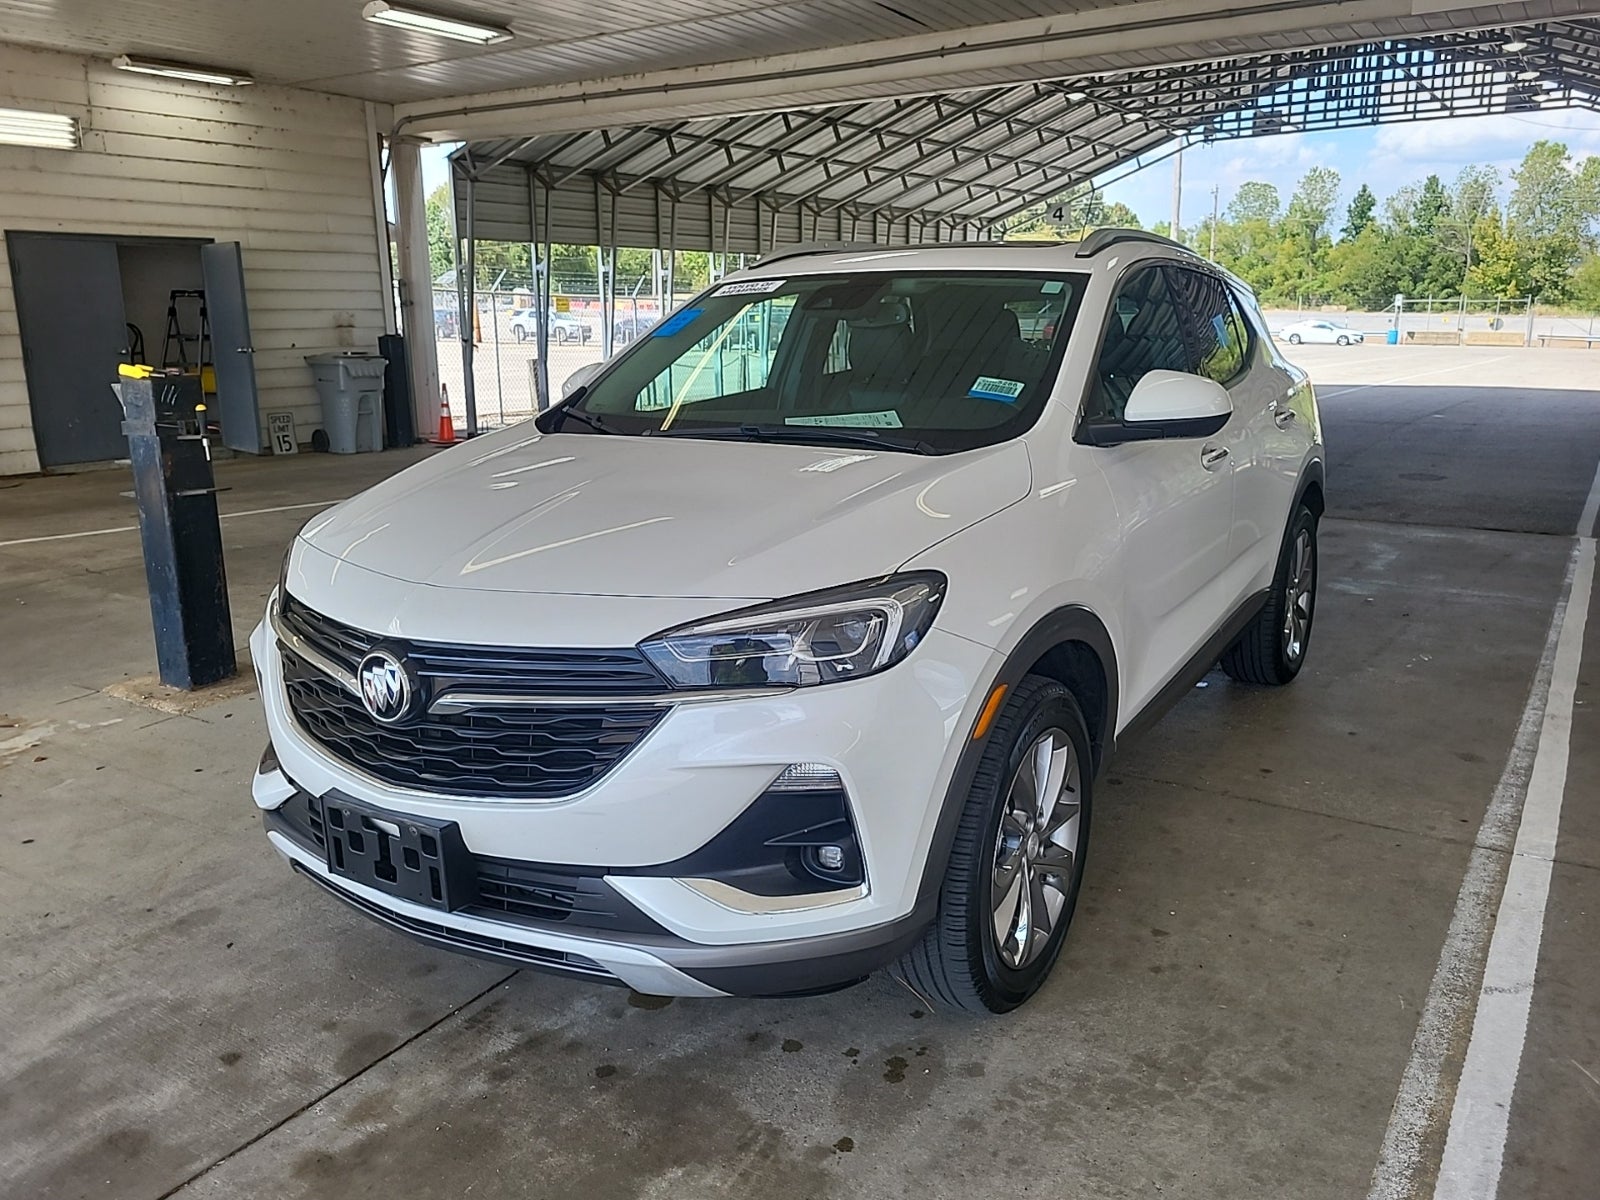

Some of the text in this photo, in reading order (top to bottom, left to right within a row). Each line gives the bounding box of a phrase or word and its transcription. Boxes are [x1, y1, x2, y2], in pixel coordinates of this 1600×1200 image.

[1052, 206, 1065, 221] 4
[270, 415, 291, 424] SPEED
[273, 424, 289, 433] LIMIT
[276, 434, 292, 452] 15
